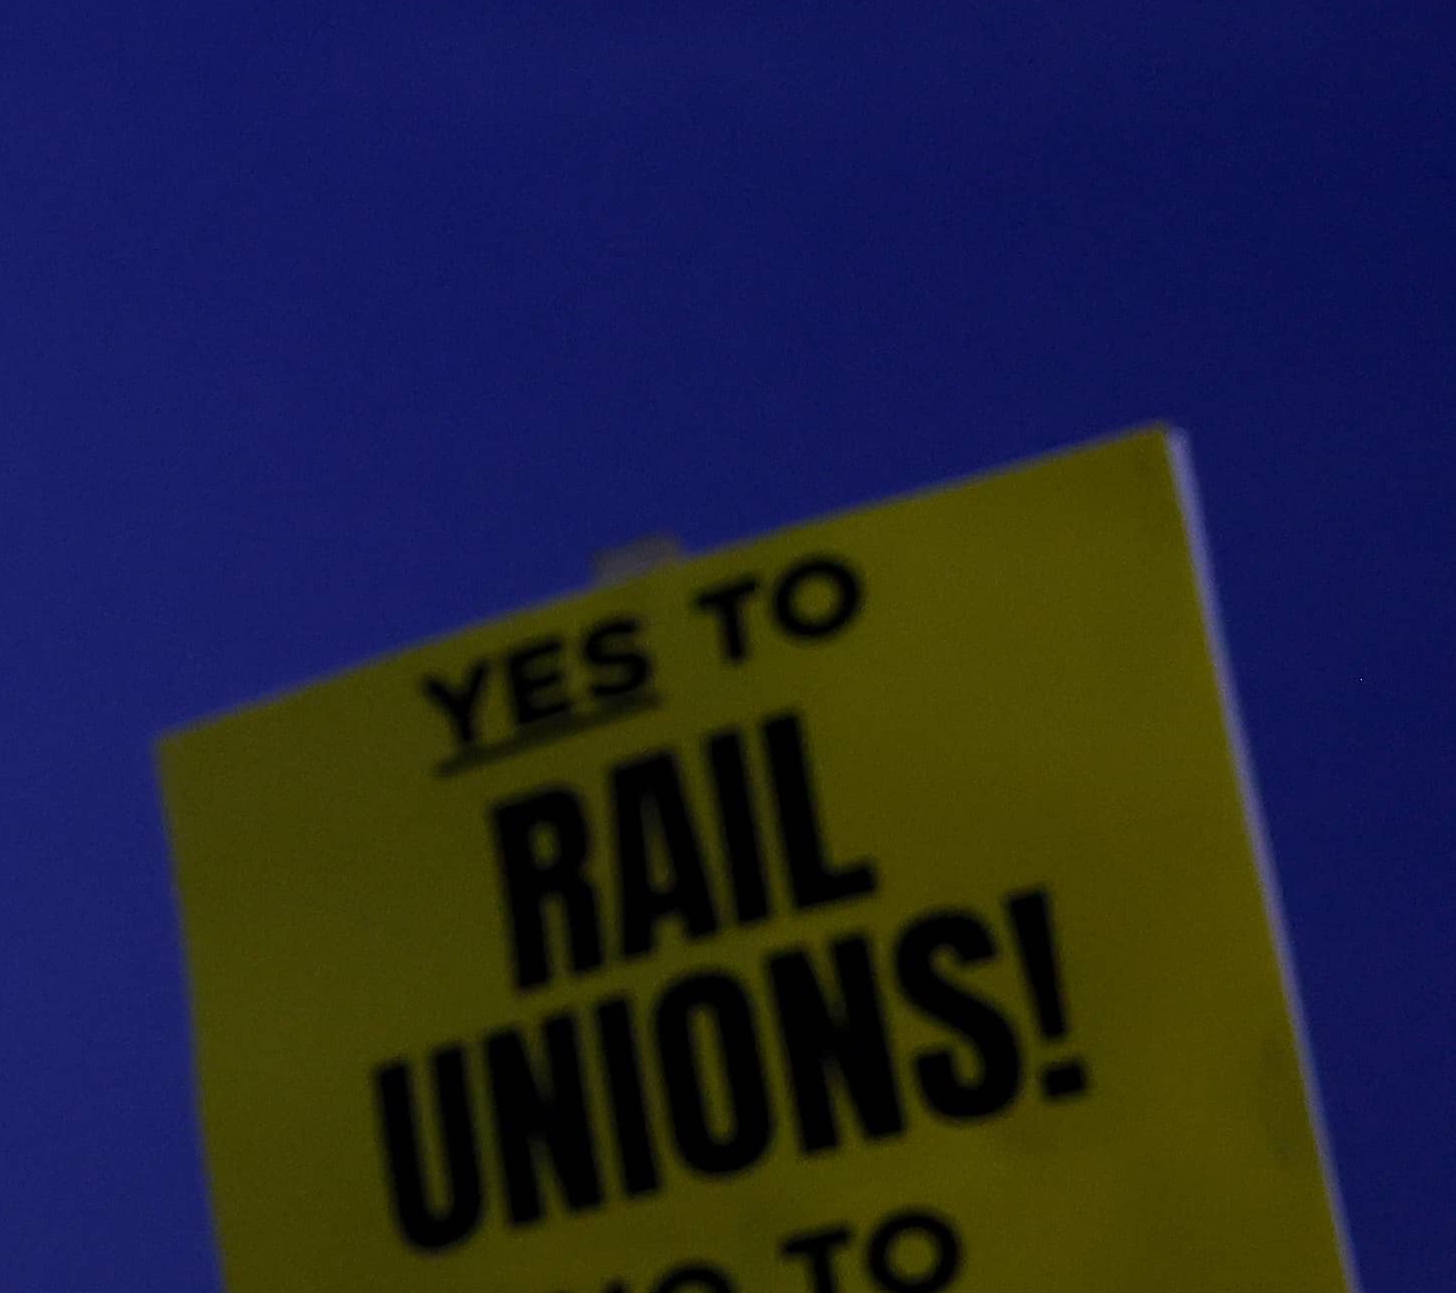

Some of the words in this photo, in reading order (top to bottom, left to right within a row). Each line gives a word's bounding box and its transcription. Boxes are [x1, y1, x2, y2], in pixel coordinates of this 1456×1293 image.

[425, 620, 648, 743] YES
[696, 560, 857, 660] TO
[493, 716, 873, 989] RAIL
[378, 894, 1085, 1249] UNIONS!
